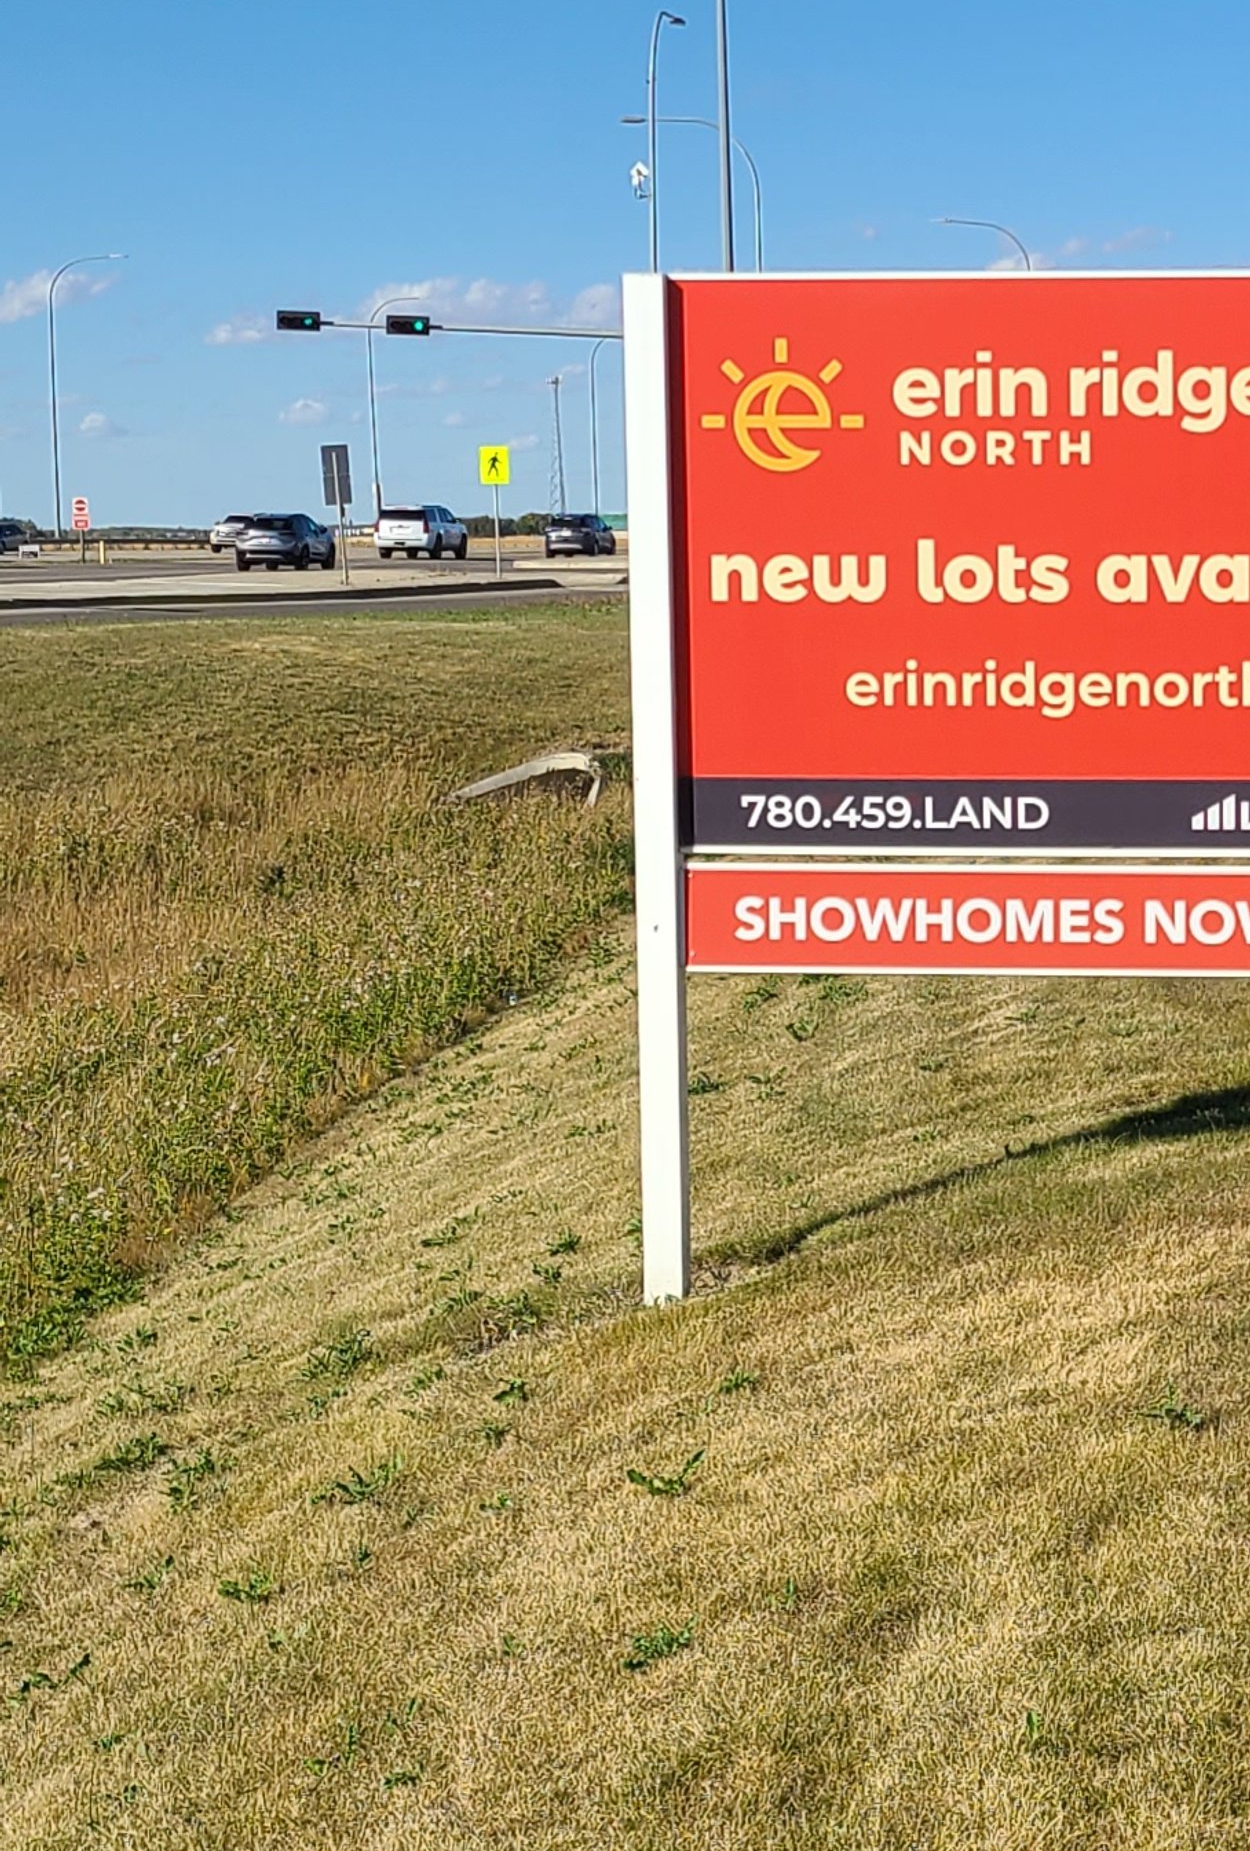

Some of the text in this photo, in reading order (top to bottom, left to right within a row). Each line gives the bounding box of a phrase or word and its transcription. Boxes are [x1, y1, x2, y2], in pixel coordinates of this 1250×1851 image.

[892, 350, 1048, 418] erin
[899, 430, 1091, 466] NORTH
[710, 554, 887, 603] new
[917, 538, 1070, 603] lots
[740, 794, 1050, 830] 780.459.LAND
[734, 895, 1125, 944] SHOWHOMES
